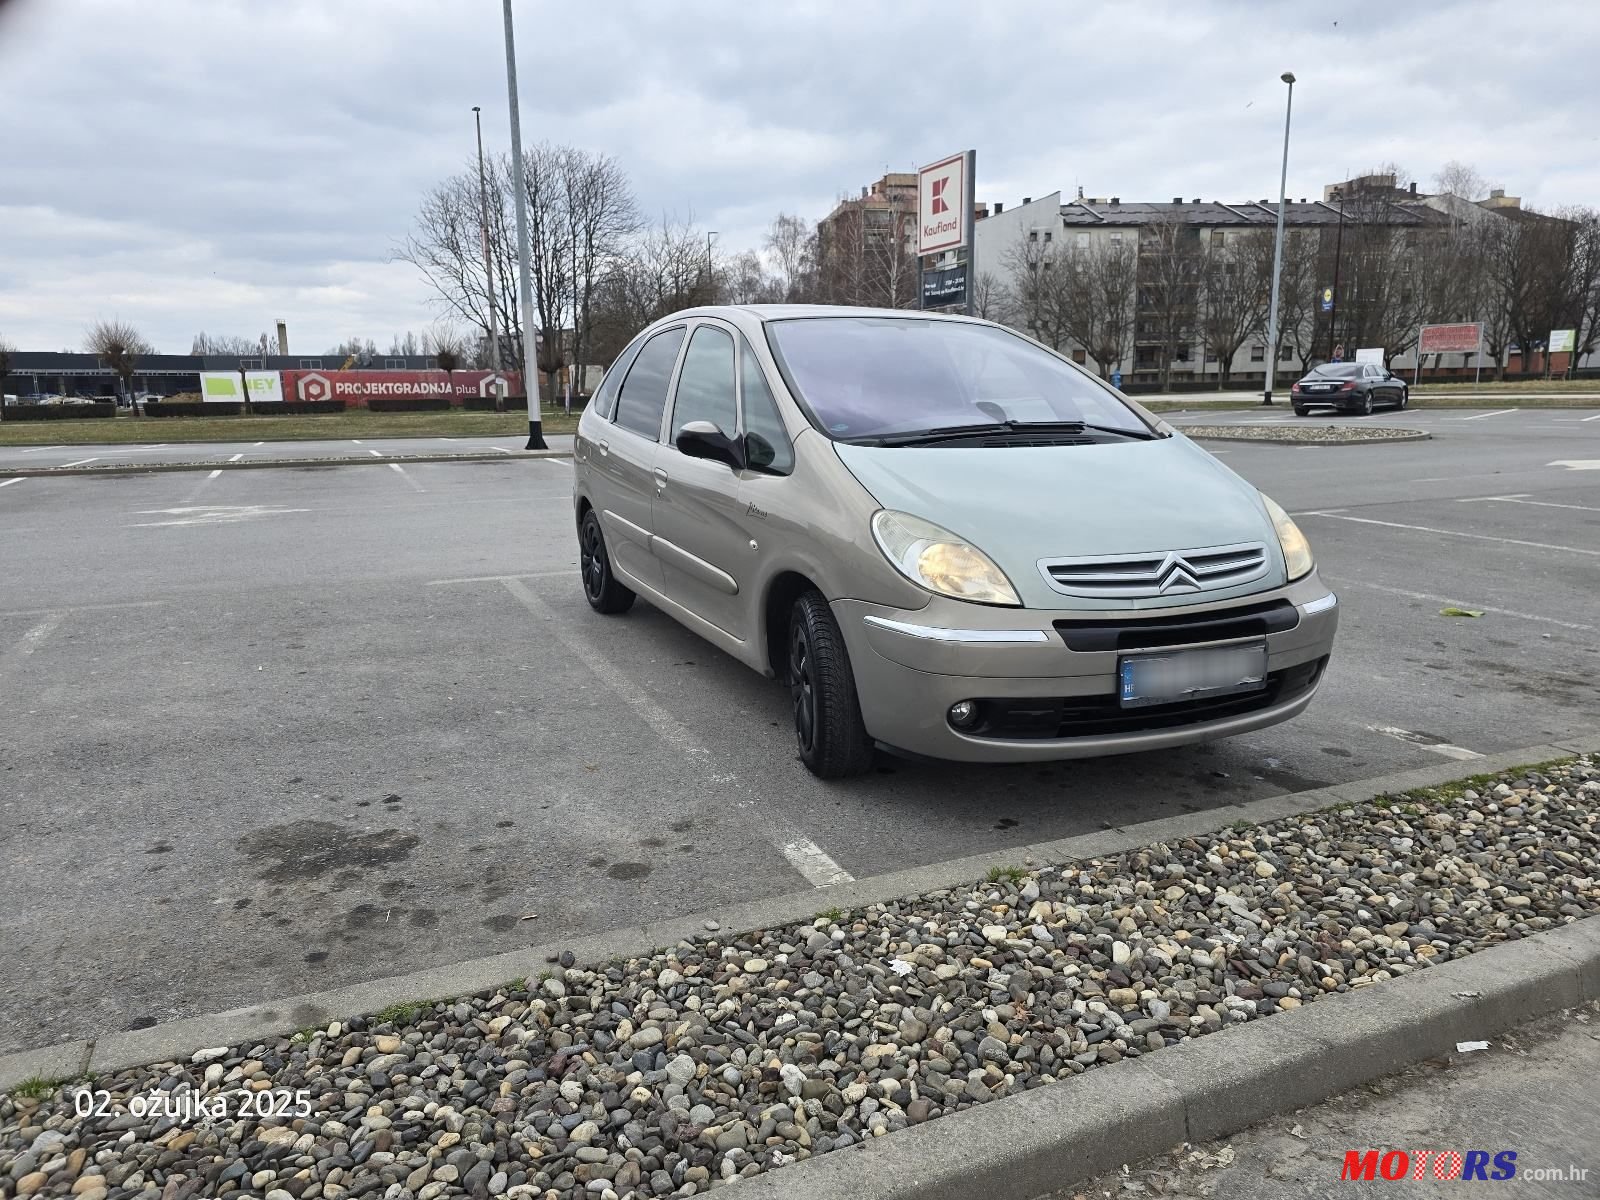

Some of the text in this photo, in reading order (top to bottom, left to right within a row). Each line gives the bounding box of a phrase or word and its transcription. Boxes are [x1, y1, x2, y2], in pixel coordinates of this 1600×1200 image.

[923, 217, 957, 238] Kaufland
[335, 382, 477, 396] PROJEKTGRADNJA plus
